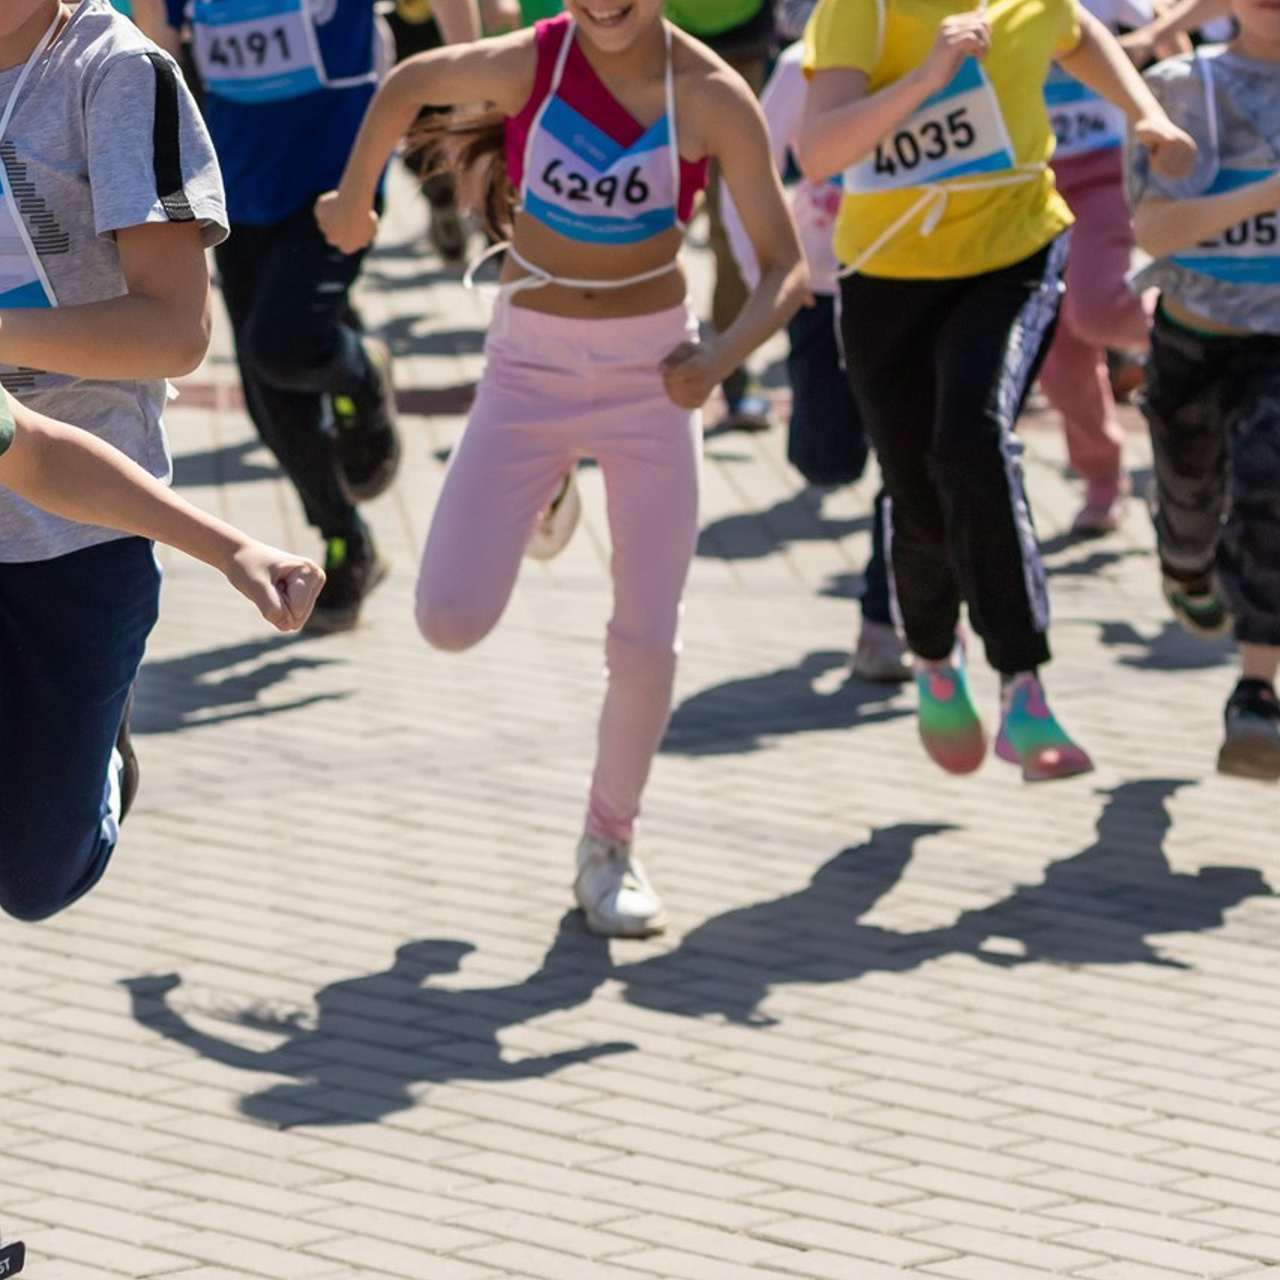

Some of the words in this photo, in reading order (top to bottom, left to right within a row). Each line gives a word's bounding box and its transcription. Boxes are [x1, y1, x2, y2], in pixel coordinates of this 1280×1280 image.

[208, 27, 292, 67] 4191
[874, 106, 977, 177] 4035
[542, 158, 650, 208] 4296
[1196, 211, 1278, 248] 05
